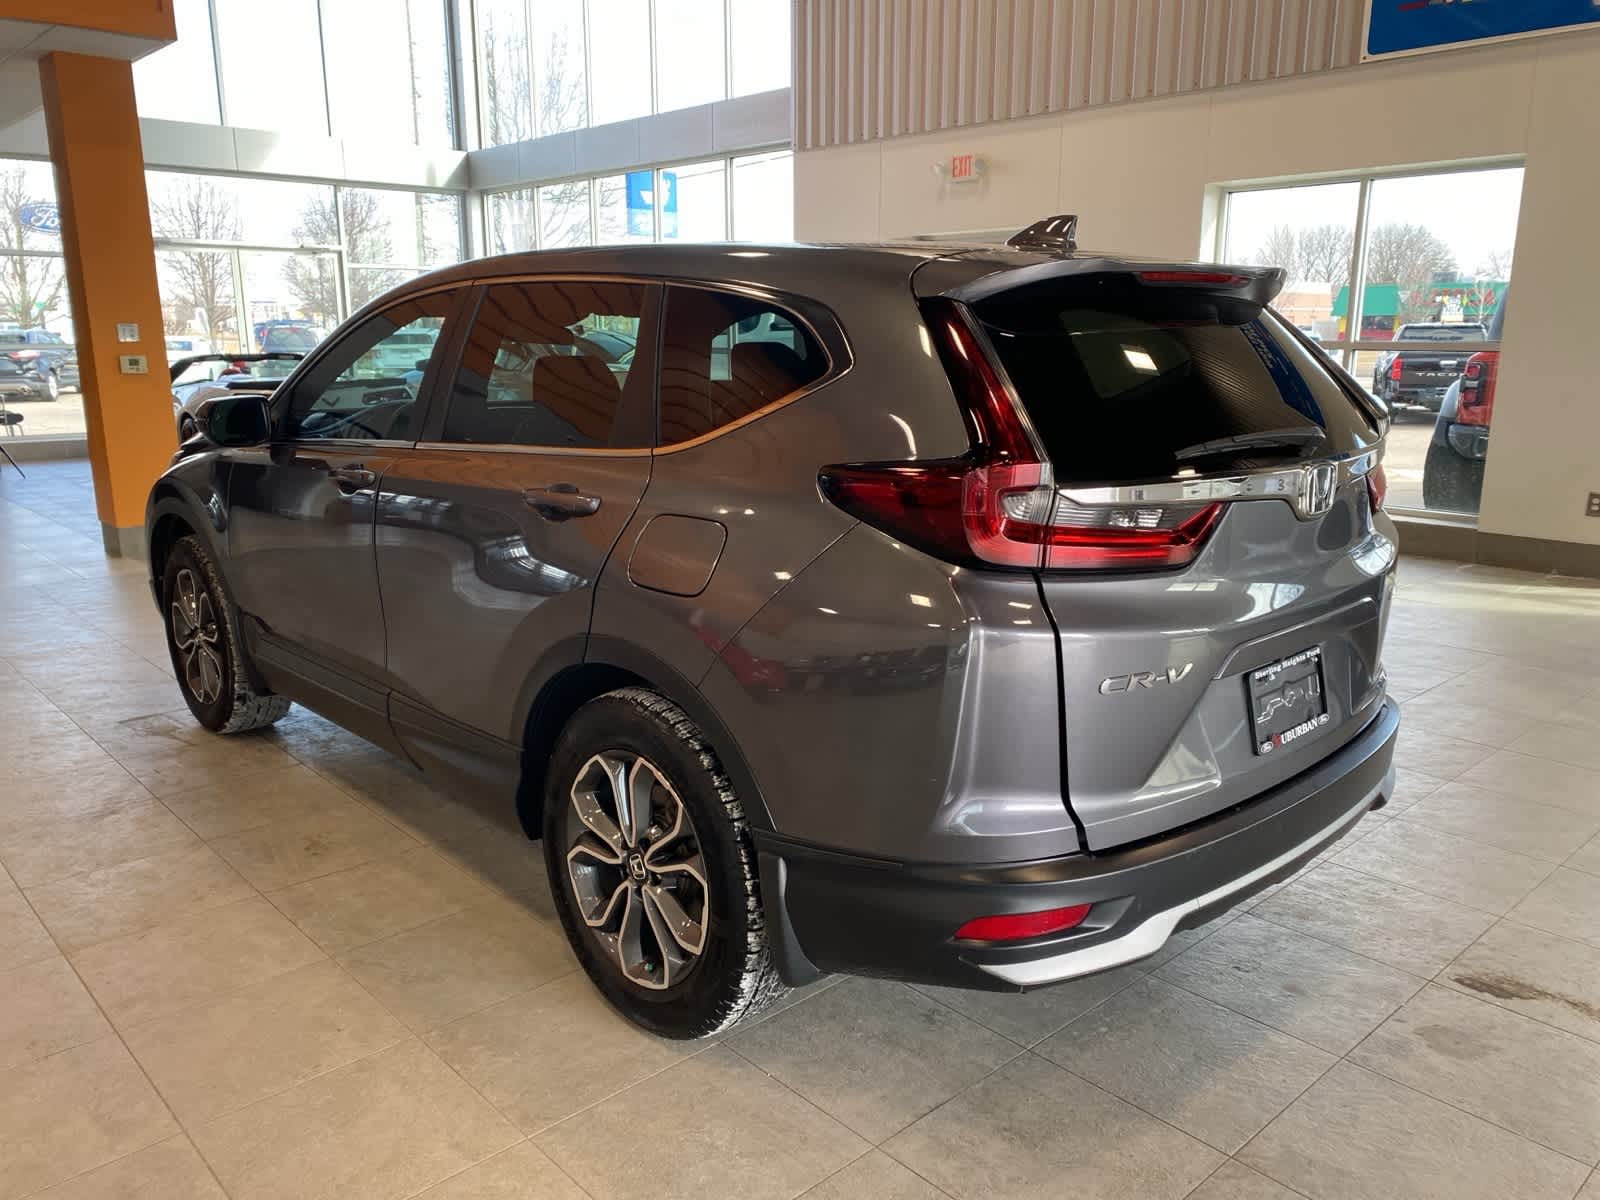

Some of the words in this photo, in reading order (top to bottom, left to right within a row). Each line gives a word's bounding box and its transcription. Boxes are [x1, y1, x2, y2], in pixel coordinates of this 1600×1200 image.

[952, 155, 973, 177] EXIT
[31, 207, 59, 227] Fo
[1255, 663, 1282, 680] Sterling
[1282, 653, 1306, 669] Heights
[1098, 662, 1193, 696] CR-V
